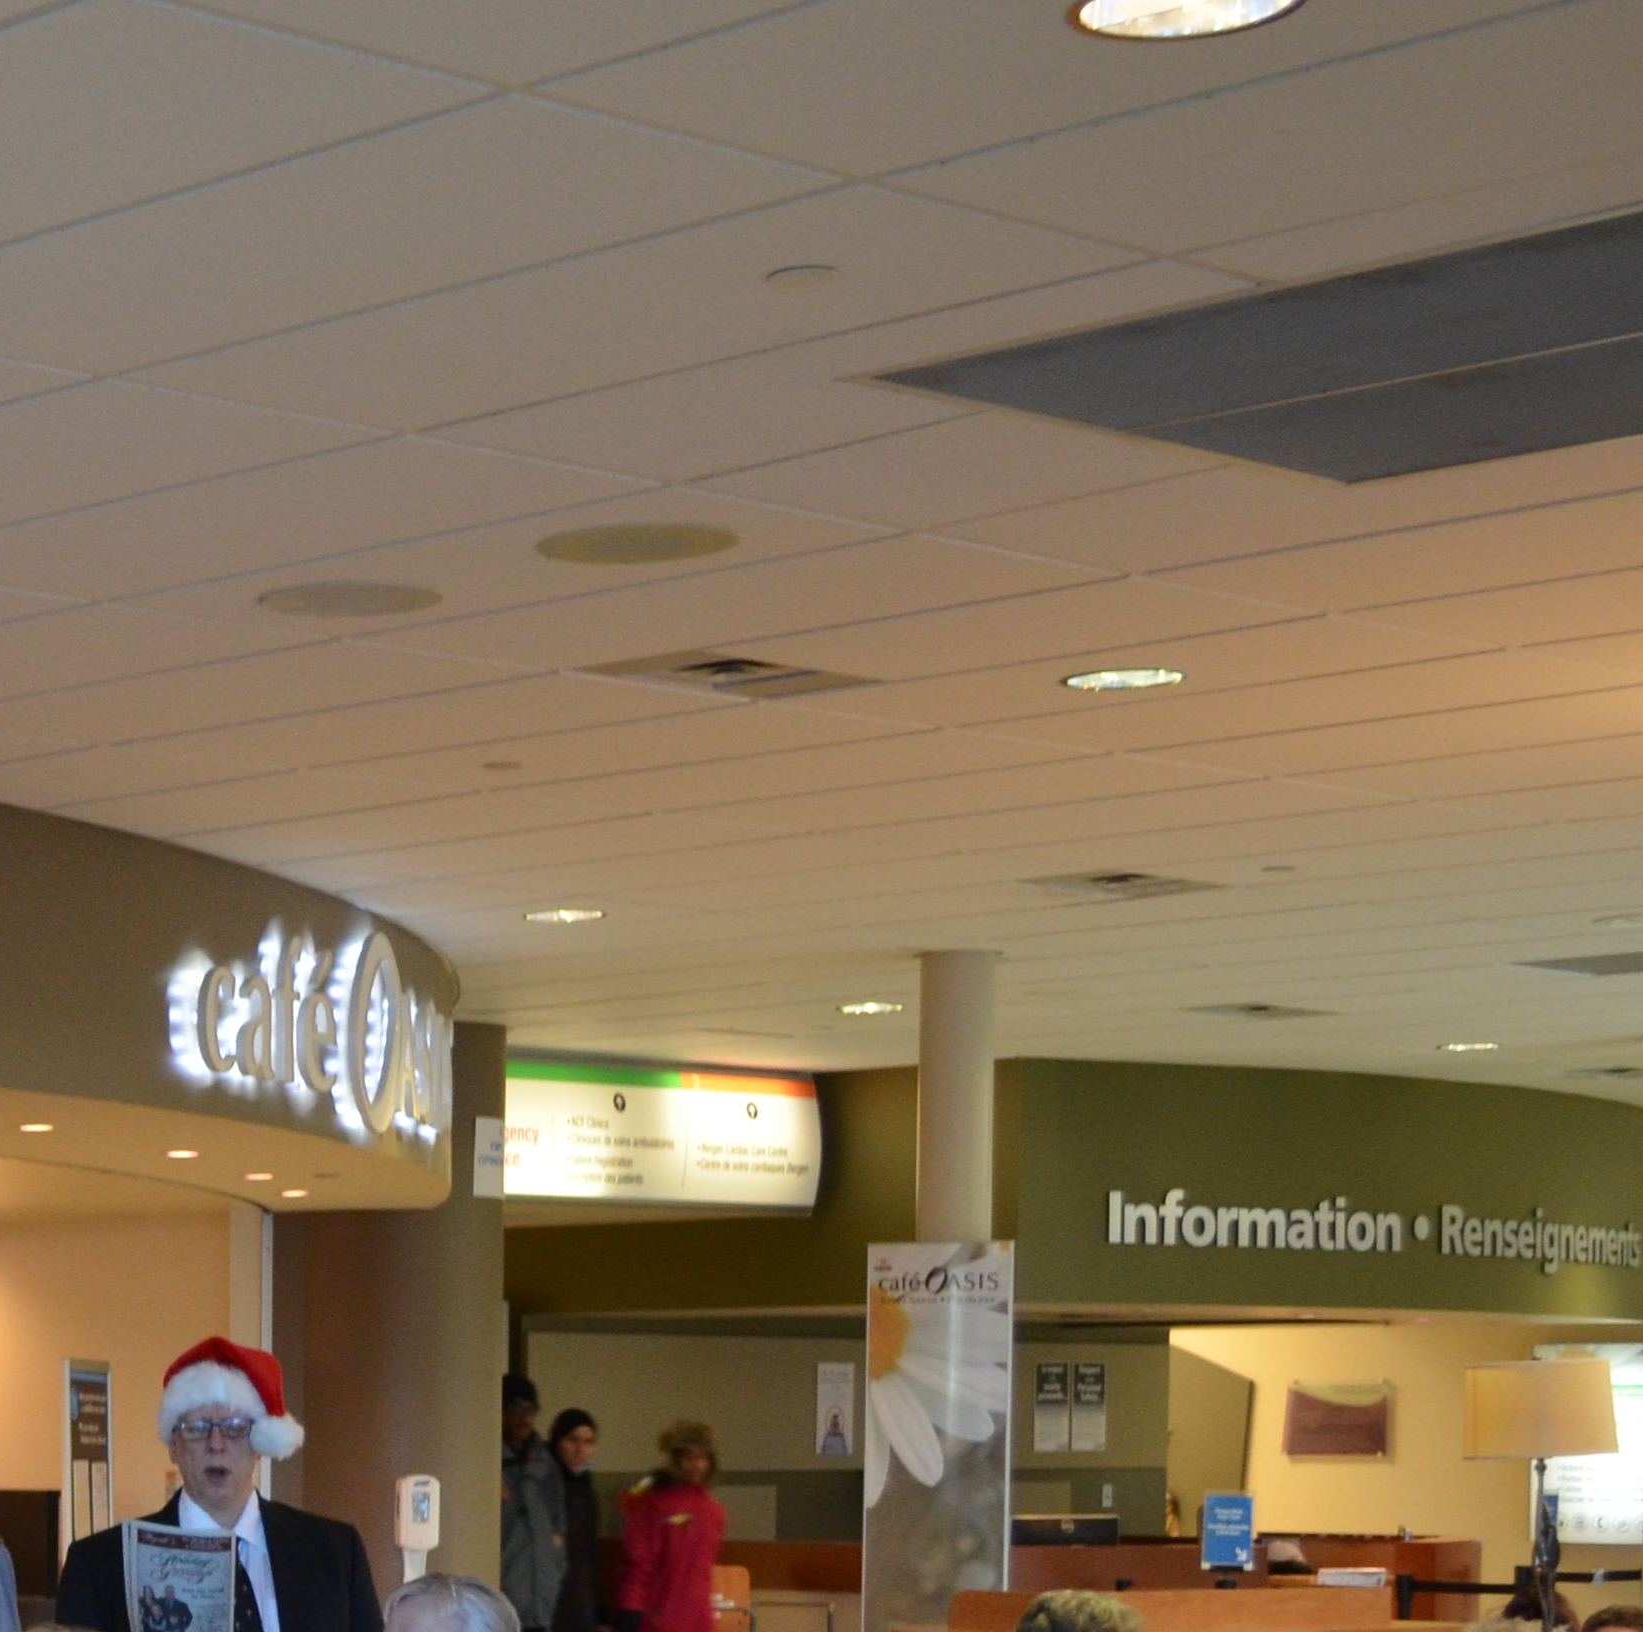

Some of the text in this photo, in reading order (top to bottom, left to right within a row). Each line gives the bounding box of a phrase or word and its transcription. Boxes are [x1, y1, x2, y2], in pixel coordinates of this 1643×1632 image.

[197, 935, 338, 1094] café
[1108, 1187, 1640, 1275] Information Renseignements
[878, 1265, 999, 1294] café OASIS
